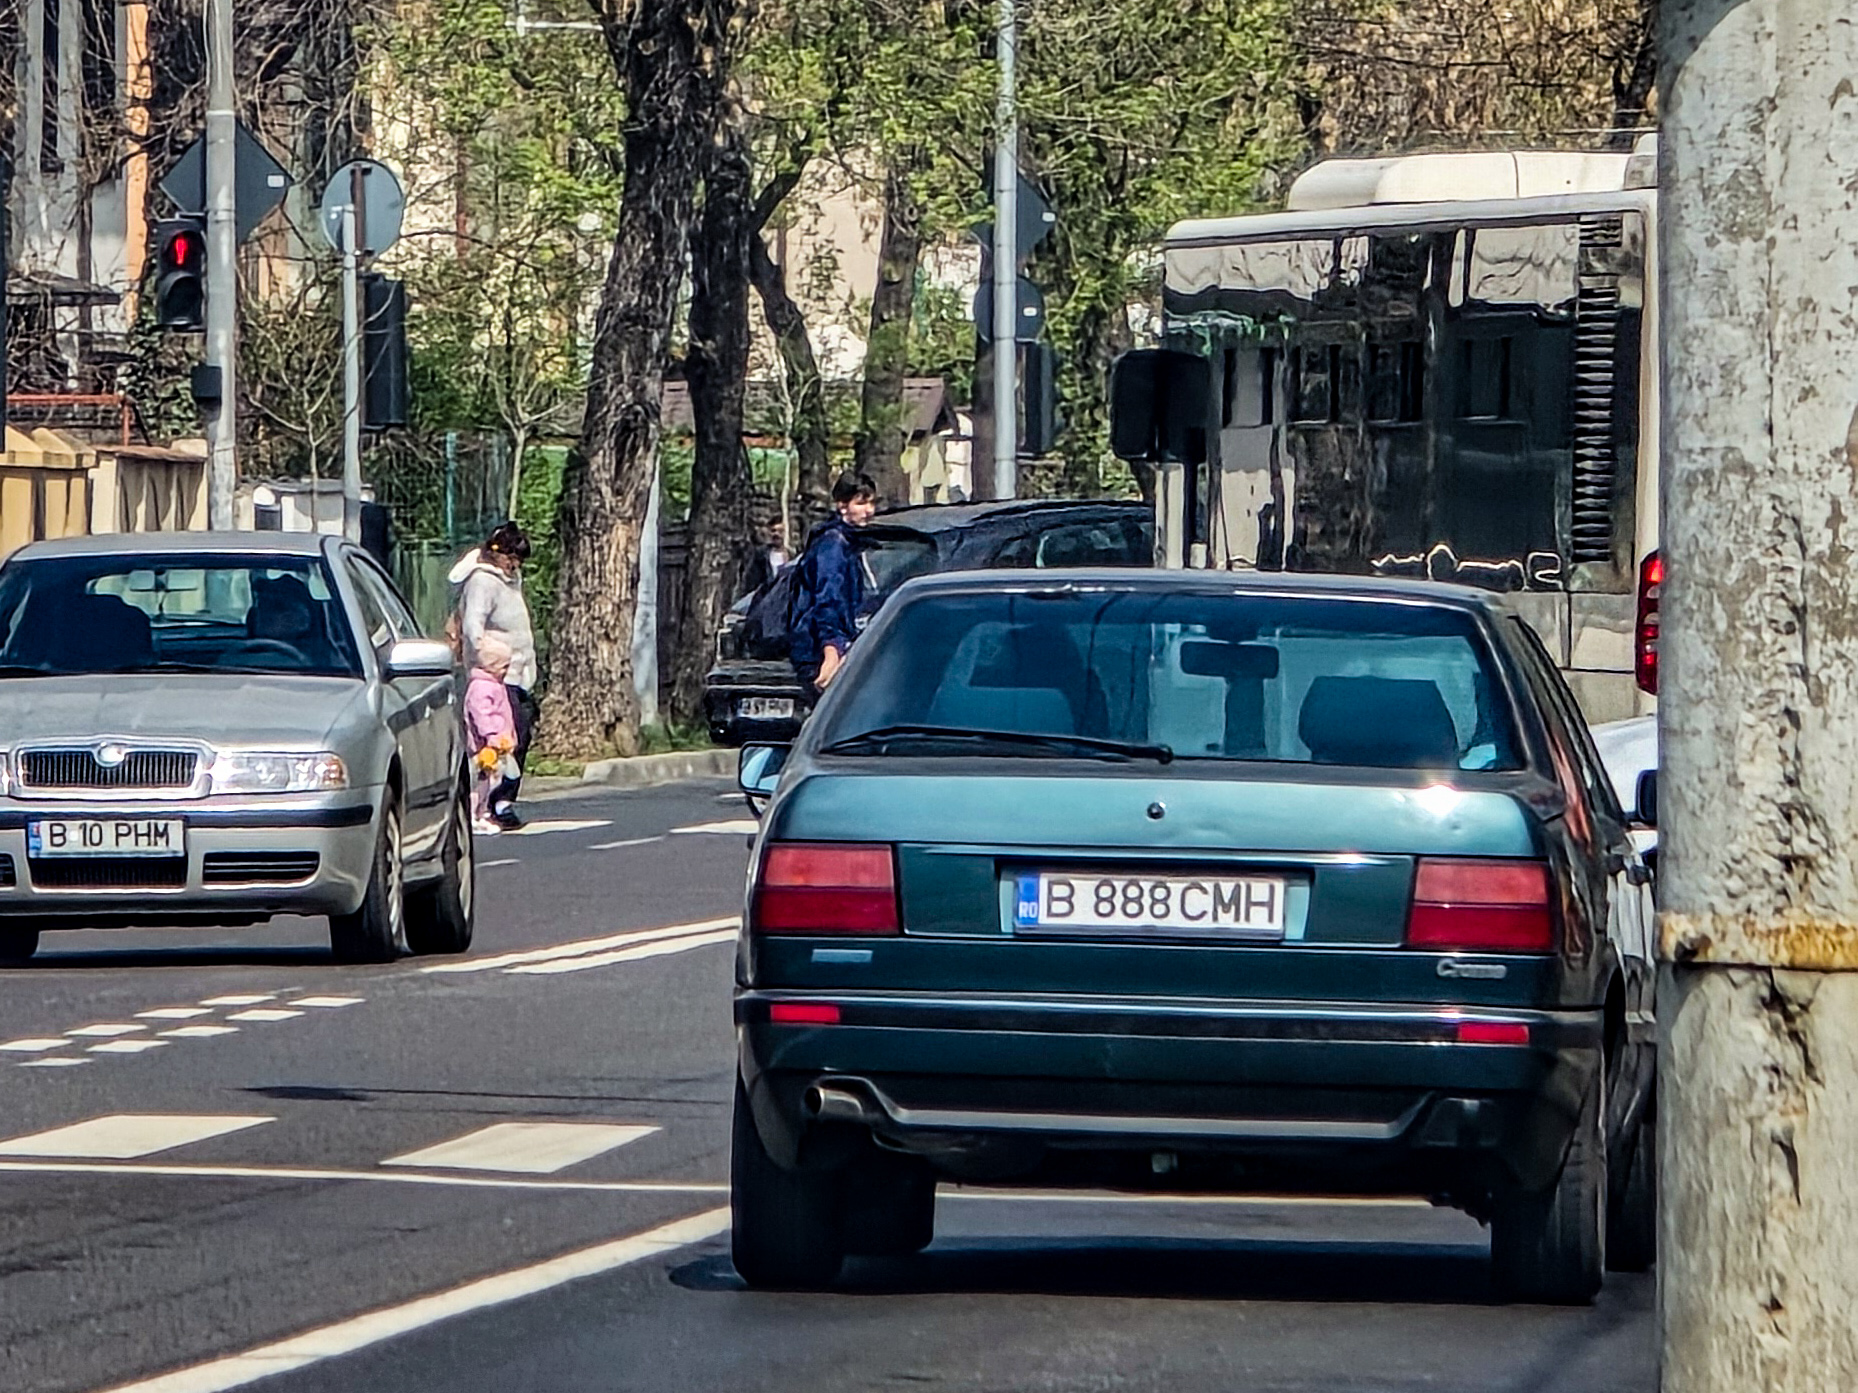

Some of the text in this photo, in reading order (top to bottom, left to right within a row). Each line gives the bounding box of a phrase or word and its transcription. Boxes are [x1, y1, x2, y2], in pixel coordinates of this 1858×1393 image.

[50, 823, 67, 847] B
[79, 822, 103, 847] 10
[114, 822, 170, 847] PHM
[1046, 880, 1075, 919] B
